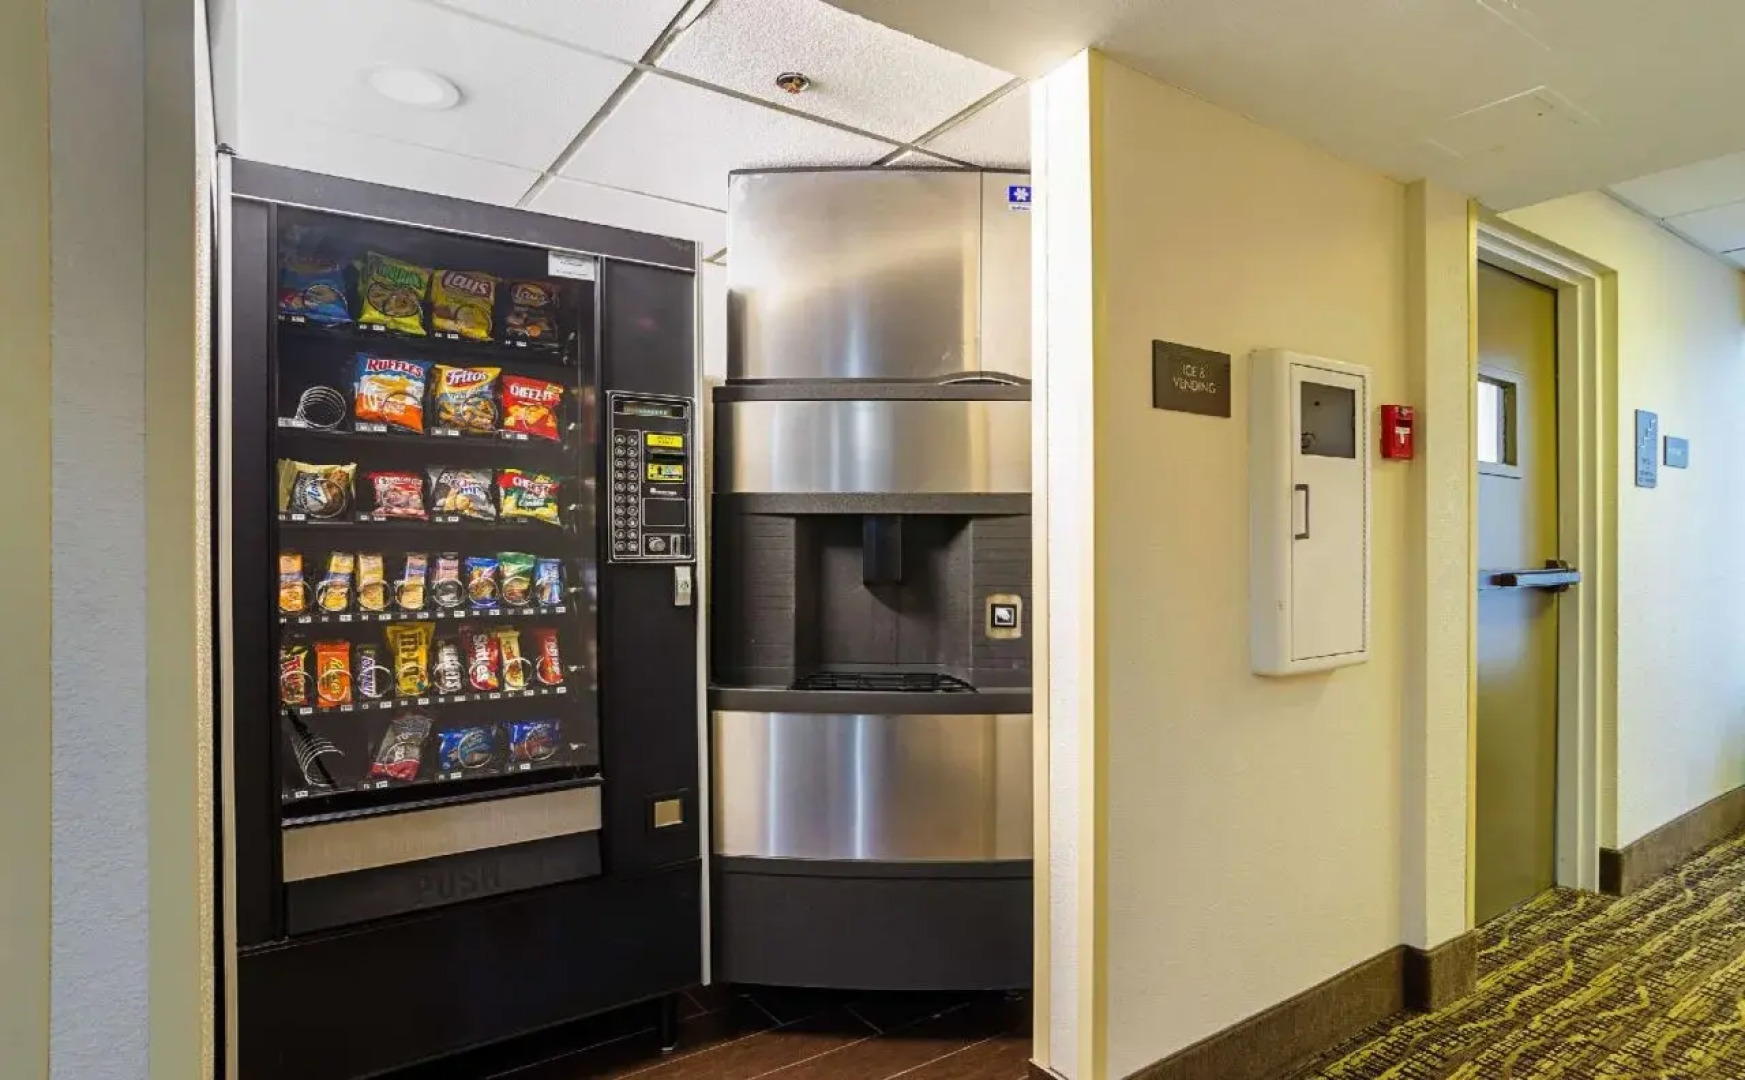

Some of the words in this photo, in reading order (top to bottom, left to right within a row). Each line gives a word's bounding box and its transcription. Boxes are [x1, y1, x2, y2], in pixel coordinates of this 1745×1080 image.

[366, 358, 424, 378] RUFFLES
[446, 368, 490, 386] Fritos
[1182, 364, 1198, 377] ICE
[1173, 376, 1217, 394] VENDING
